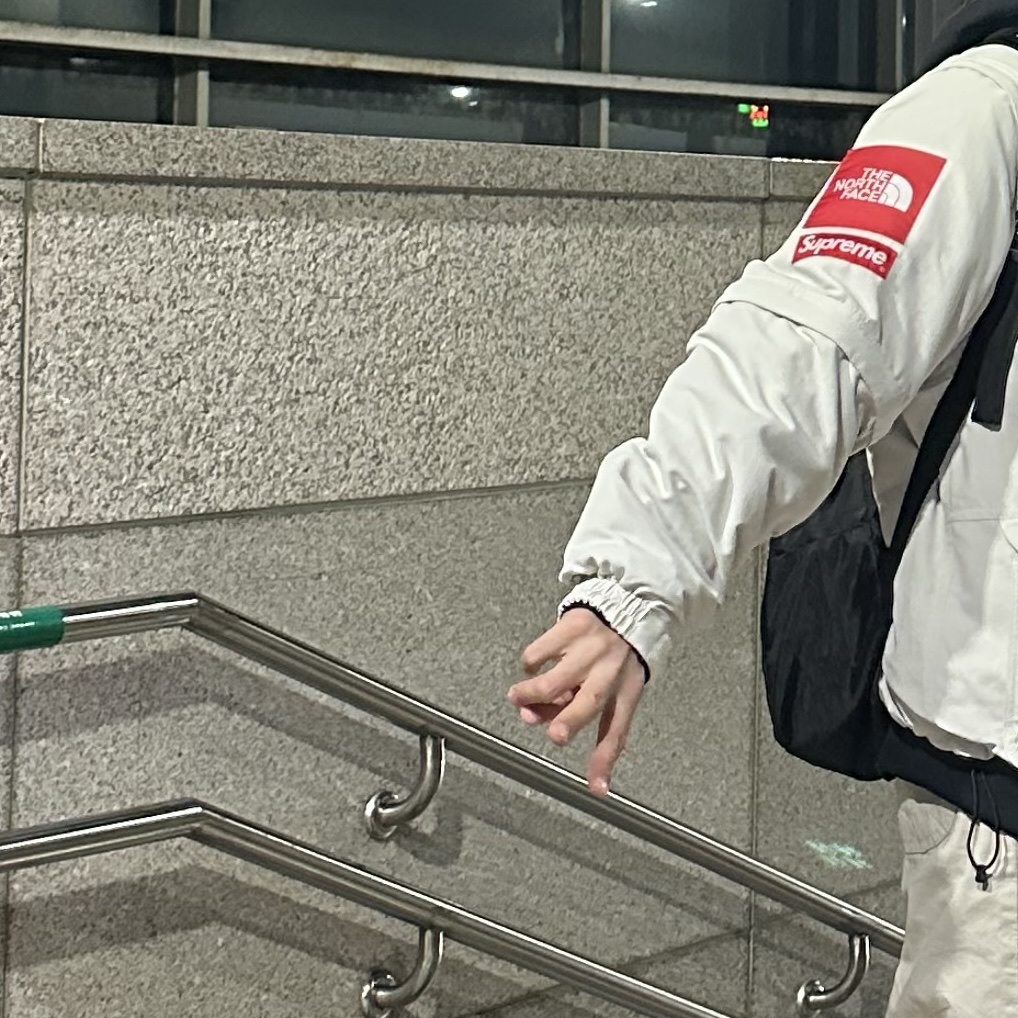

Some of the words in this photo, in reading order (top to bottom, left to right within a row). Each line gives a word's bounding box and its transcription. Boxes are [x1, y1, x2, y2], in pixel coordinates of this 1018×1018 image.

[862, 167, 893, 181] THE
[834, 178, 887, 193] NORTH
[840, 188, 881, 202] FACE
[798, 235, 888, 265] Supreme
